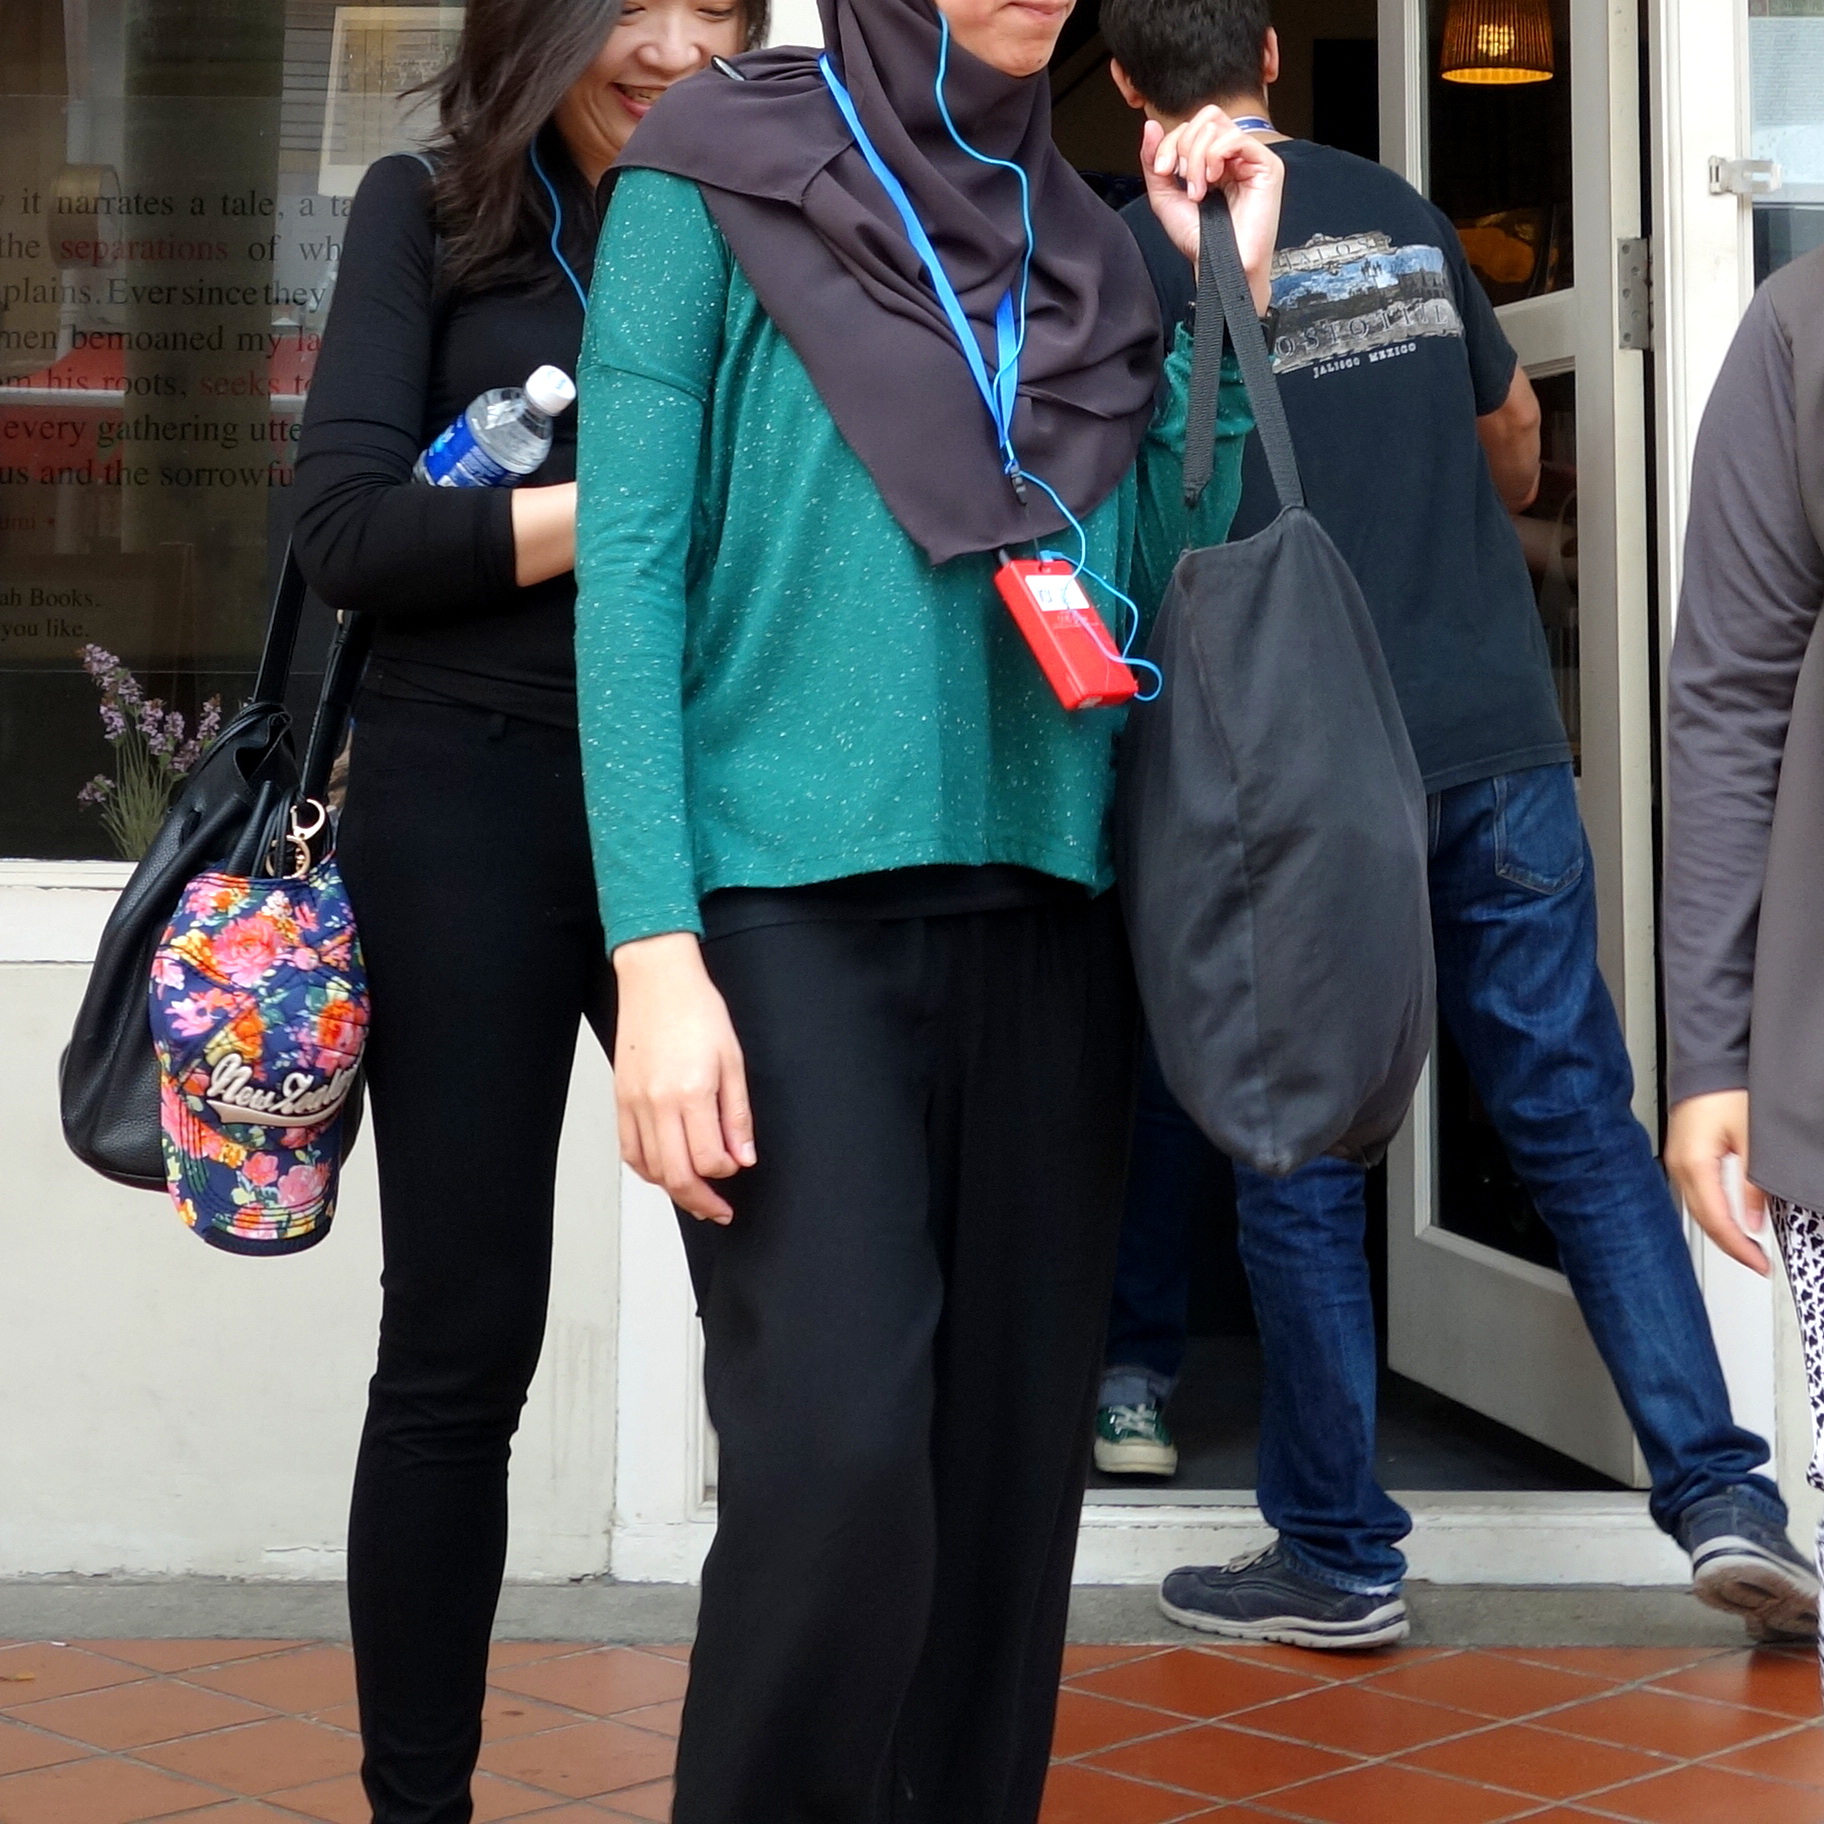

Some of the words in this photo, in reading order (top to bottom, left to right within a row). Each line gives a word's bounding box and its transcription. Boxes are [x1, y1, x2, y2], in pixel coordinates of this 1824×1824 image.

[21, 188, 41, 214] it
[55, 192, 180, 216] narrates
[190, 195, 205, 216] a
[222, 190, 284, 220] tale,
[298, 197, 314, 217] a
[331, 192, 353, 217] ta
[60, 235, 228, 269] separations
[248, 235, 280, 260] of
[299, 236, 339, 262] wh
[108, 279, 180, 305] Ever
[182, 280, 257, 305] since
[264, 281, 325, 312] they
[71, 325, 223, 352] bemoaned
[237, 331, 283, 360] my
[297, 327, 320, 353] la
[1313, 357, 1360, 379] JALISCO
[1369, 342, 1417, 363] MEXICO
[48, 369, 88, 390] his
[103, 374, 188, 398] roots,
[200, 372, 282, 396] seeks
[3, 418, 85, 445] every
[97, 418, 238, 448] gathering
[250, 420, 302, 442] utte
[40, 460, 92, 486] and
[103, 460, 150, 486] the
[160, 460, 293, 488] sorrowfu
[30, 588, 101, 608] Books.
[1, 624, 38, 643] you
[47, 619, 89, 638] like.
[207, 1053, 276, 1110] New
